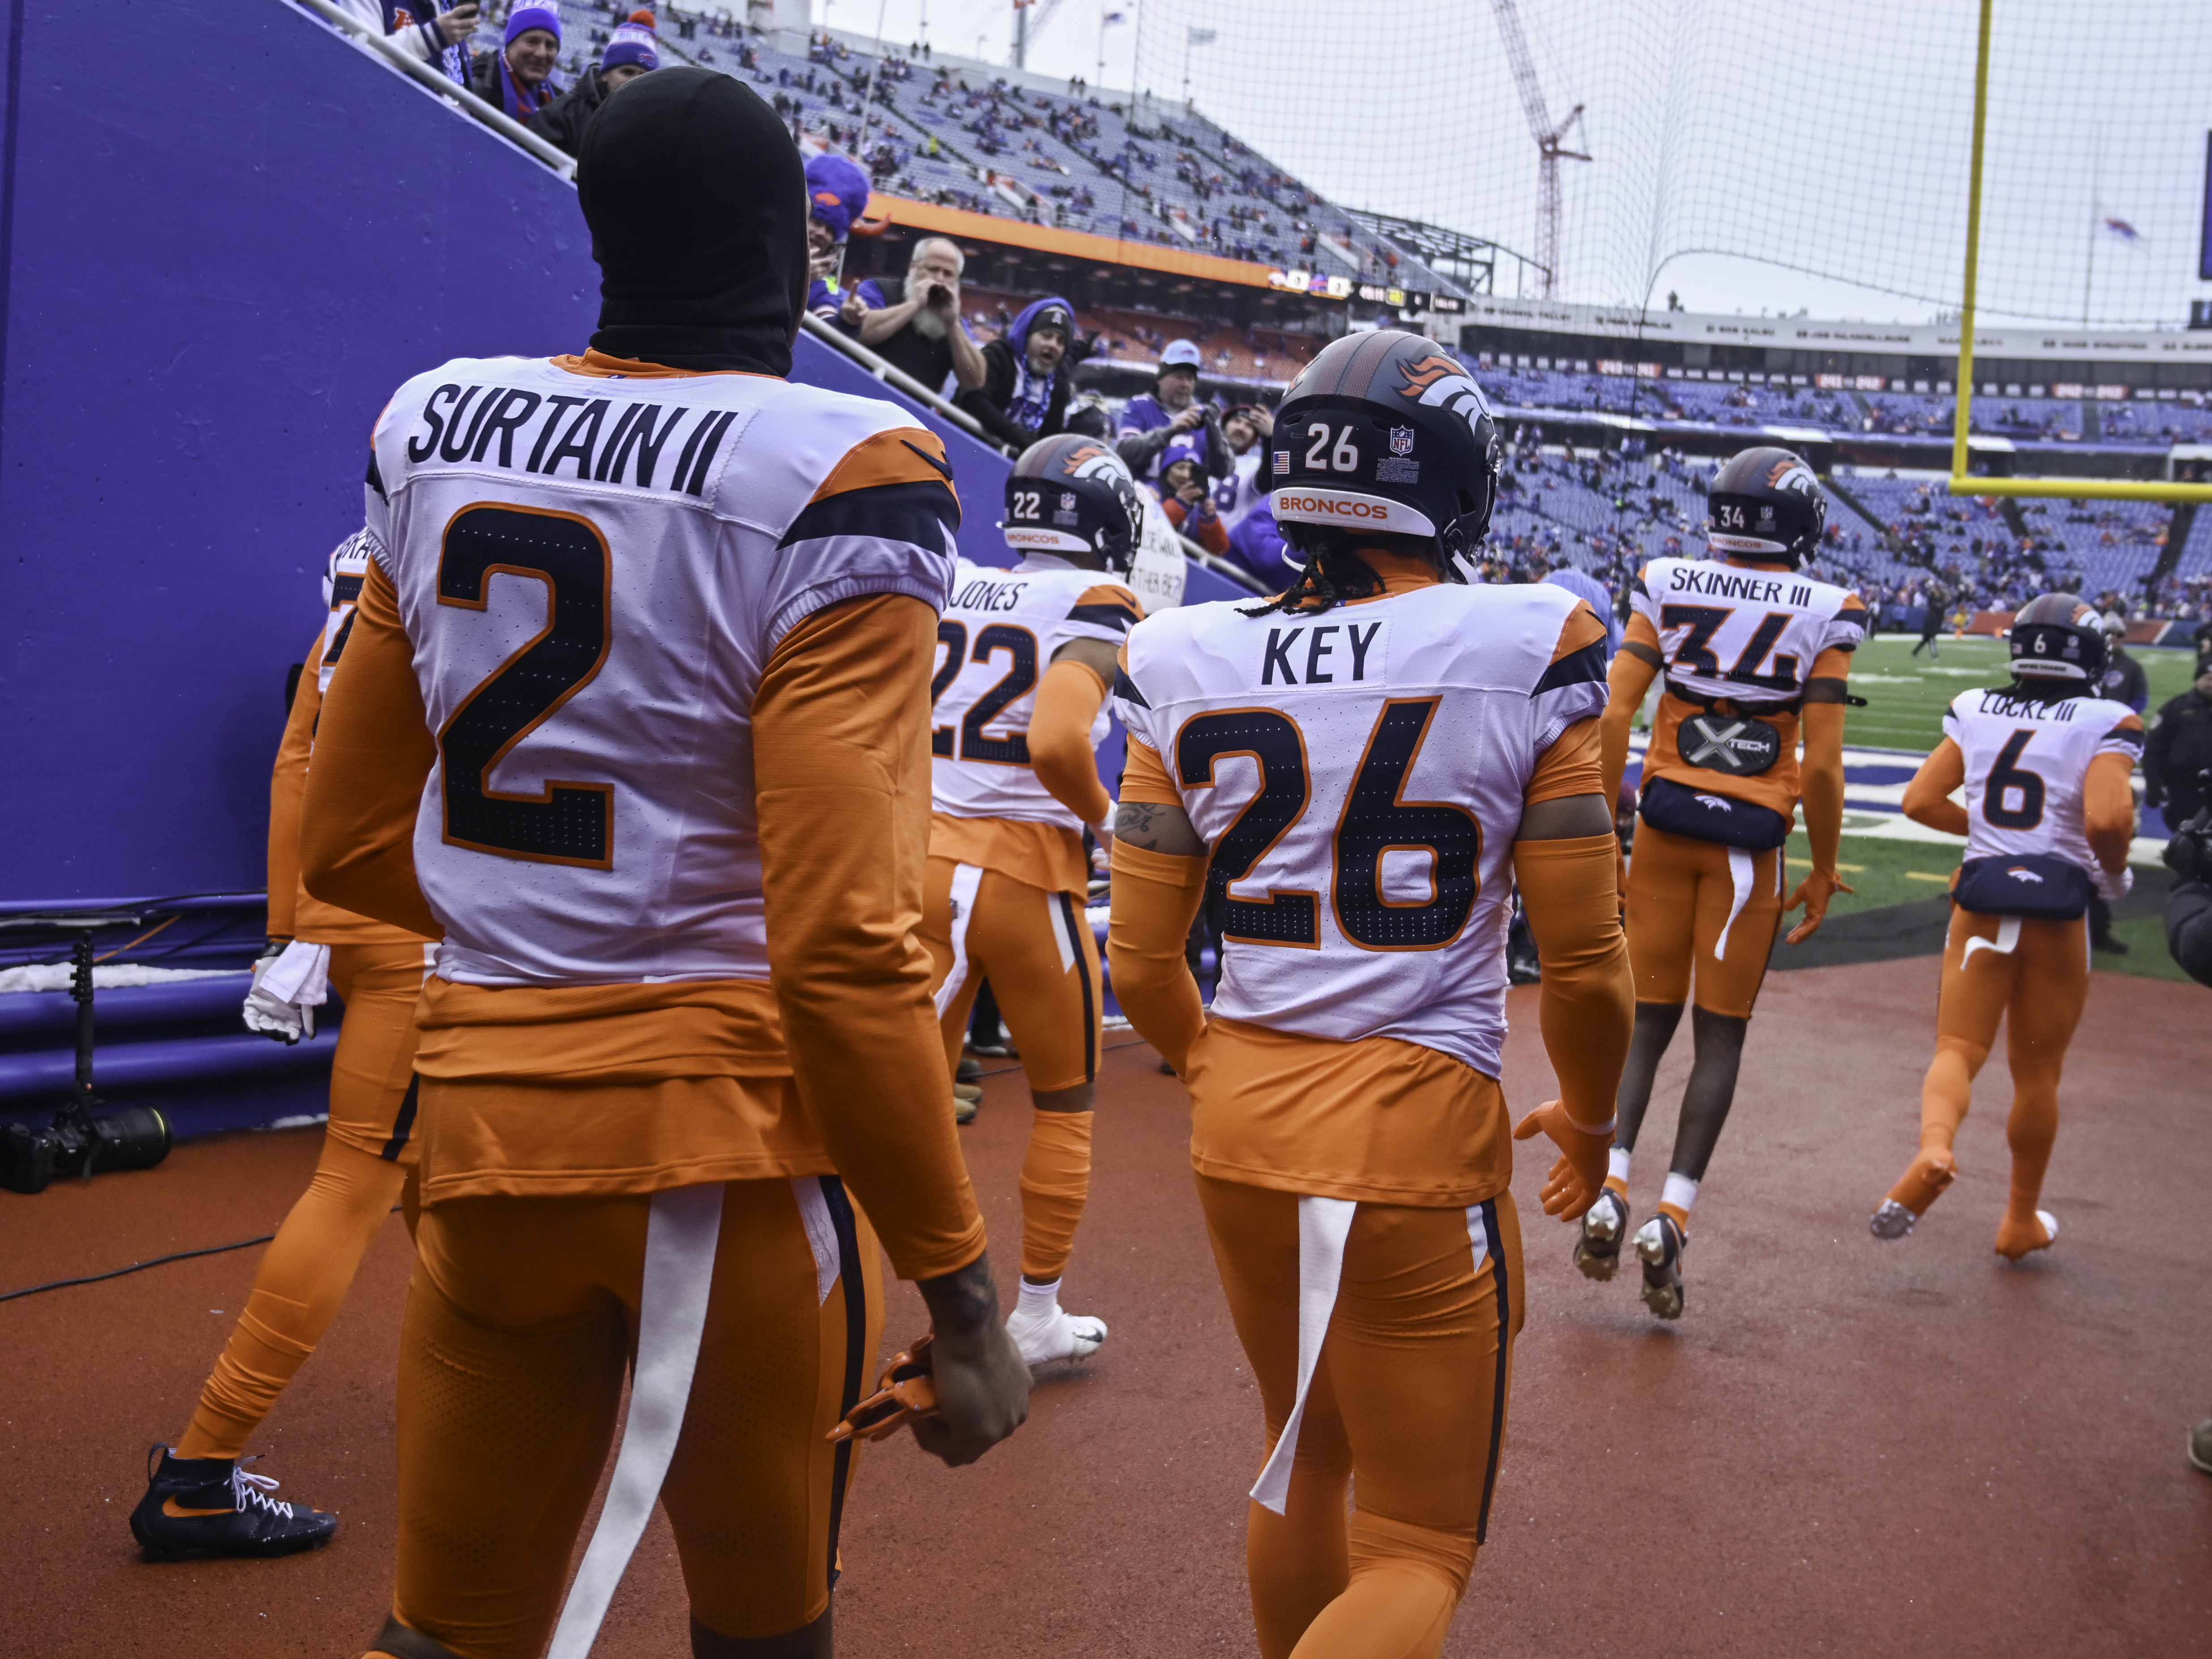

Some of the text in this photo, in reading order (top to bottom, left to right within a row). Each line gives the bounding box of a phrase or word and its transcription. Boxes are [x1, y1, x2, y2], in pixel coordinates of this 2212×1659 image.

[408, 384, 738, 496] SURTAIN II
[1305, 422, 1359, 473] 26
[1393, 438, 1410, 451] NFL
[1014, 491, 1040, 520] 22
[1280, 497, 1387, 520] BRONCOS
[1720, 505, 1744, 529] 34
[949, 581, 1029, 611] JONES
[1670, 566, 1812, 608] SKINNER III
[1261, 621, 1382, 685] KEY
[1660, 603, 1799, 692] 34
[2034, 633, 2046, 654] 6
[436, 500, 614, 871] 2
[2054, 701, 2078, 722] III
[1982, 728, 2045, 832] 6
[1174, 694, 1484, 952] 26
